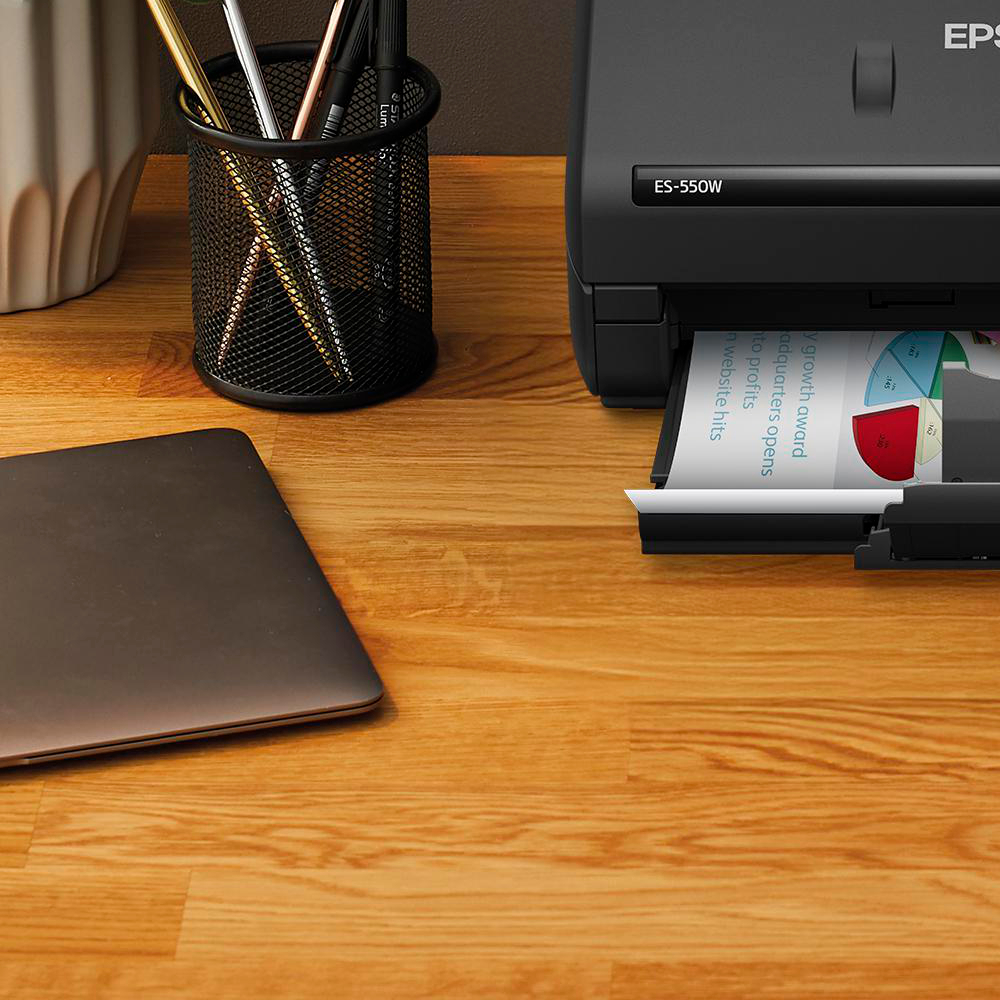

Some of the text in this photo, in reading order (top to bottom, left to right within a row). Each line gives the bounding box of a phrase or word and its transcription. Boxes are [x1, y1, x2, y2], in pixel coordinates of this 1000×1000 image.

[654, 179, 723, 193] ES-550W
[709, 346, 737, 441] website hits
[742, 357, 762, 410] profits
[792, 345, 817, 458] growth award
[761, 425, 779, 477] opens
